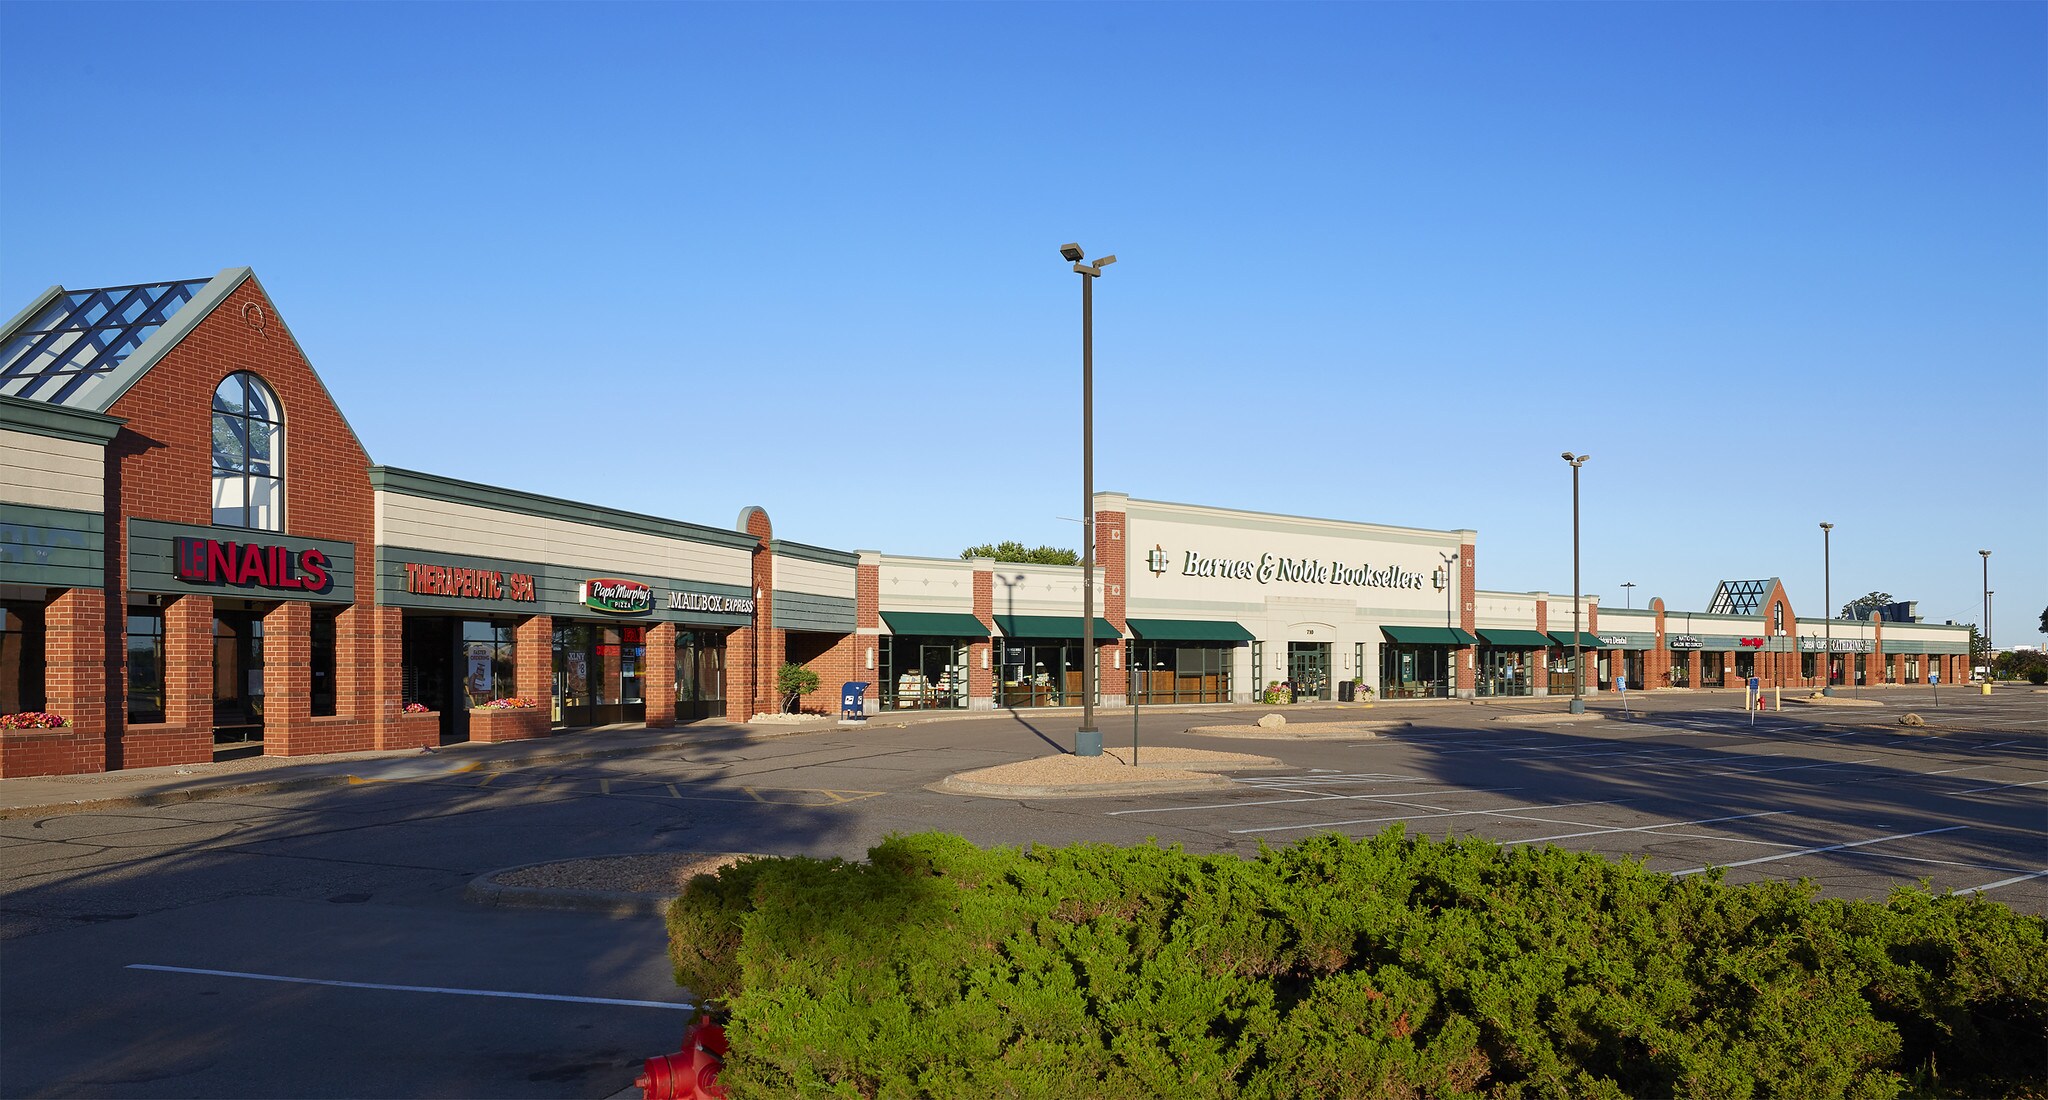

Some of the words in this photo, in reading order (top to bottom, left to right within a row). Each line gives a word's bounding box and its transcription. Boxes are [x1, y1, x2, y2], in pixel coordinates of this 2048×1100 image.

[181, 539, 205, 578] LE
[207, 539, 327, 591] NAILS
[405, 563, 502, 599] THERAPEUTIC
[511, 573, 535, 601] SPA
[1182, 550, 1255, 580] Barnes
[1257, 552, 1275, 585] &
[1276, 557, 1327, 585] Noble
[1330, 561, 1424, 590] Booksellers
[594, 582, 616, 604] Papa
[615, 584, 650, 606] Murphy's
[725, 598, 754, 613] EXPRESS
